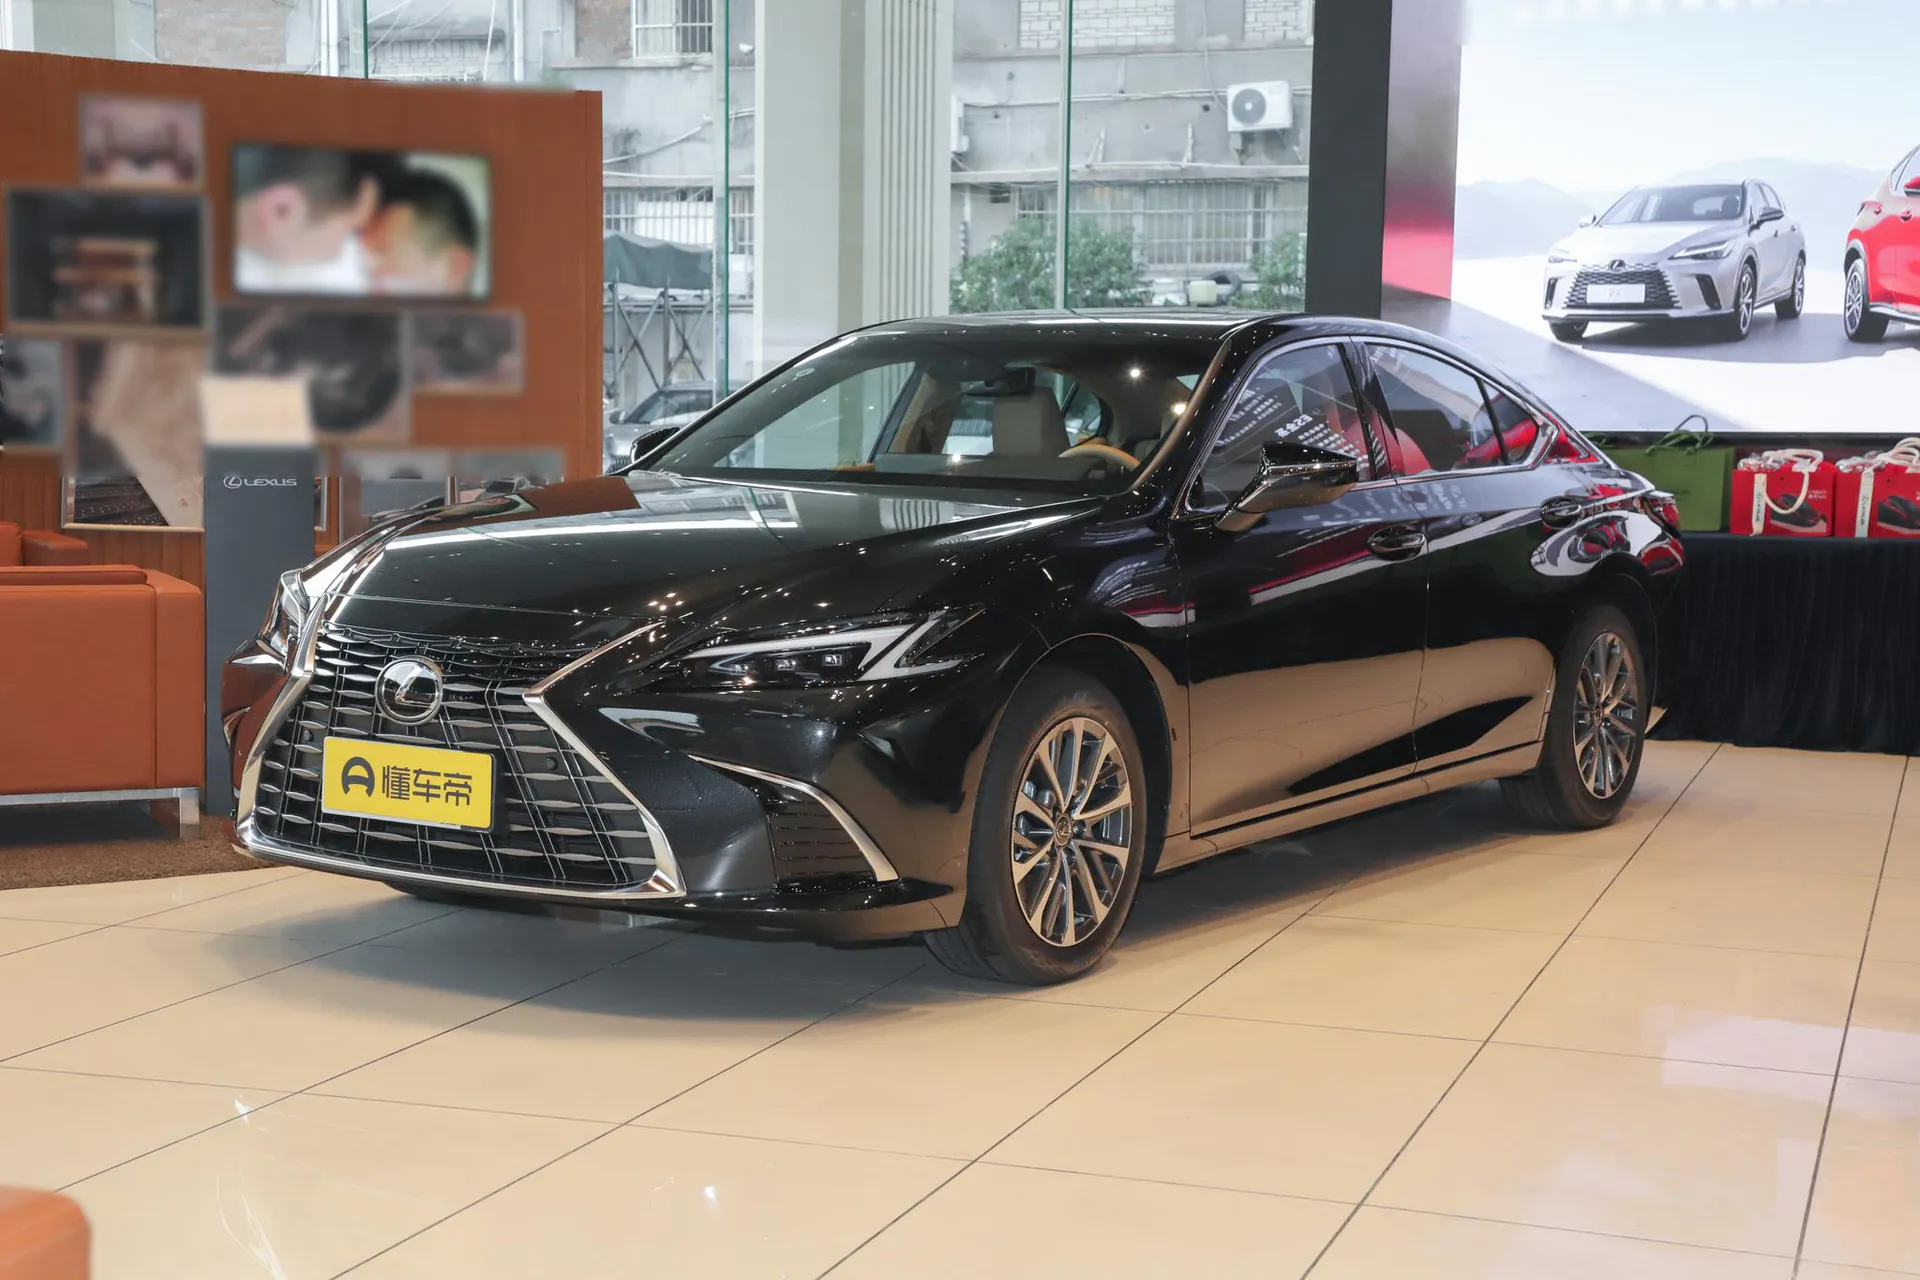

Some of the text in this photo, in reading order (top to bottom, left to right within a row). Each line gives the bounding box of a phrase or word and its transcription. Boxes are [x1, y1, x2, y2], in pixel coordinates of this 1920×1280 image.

[243, 478, 298, 487] LEXUS
[381, 765, 472, 806] 懂车帝
